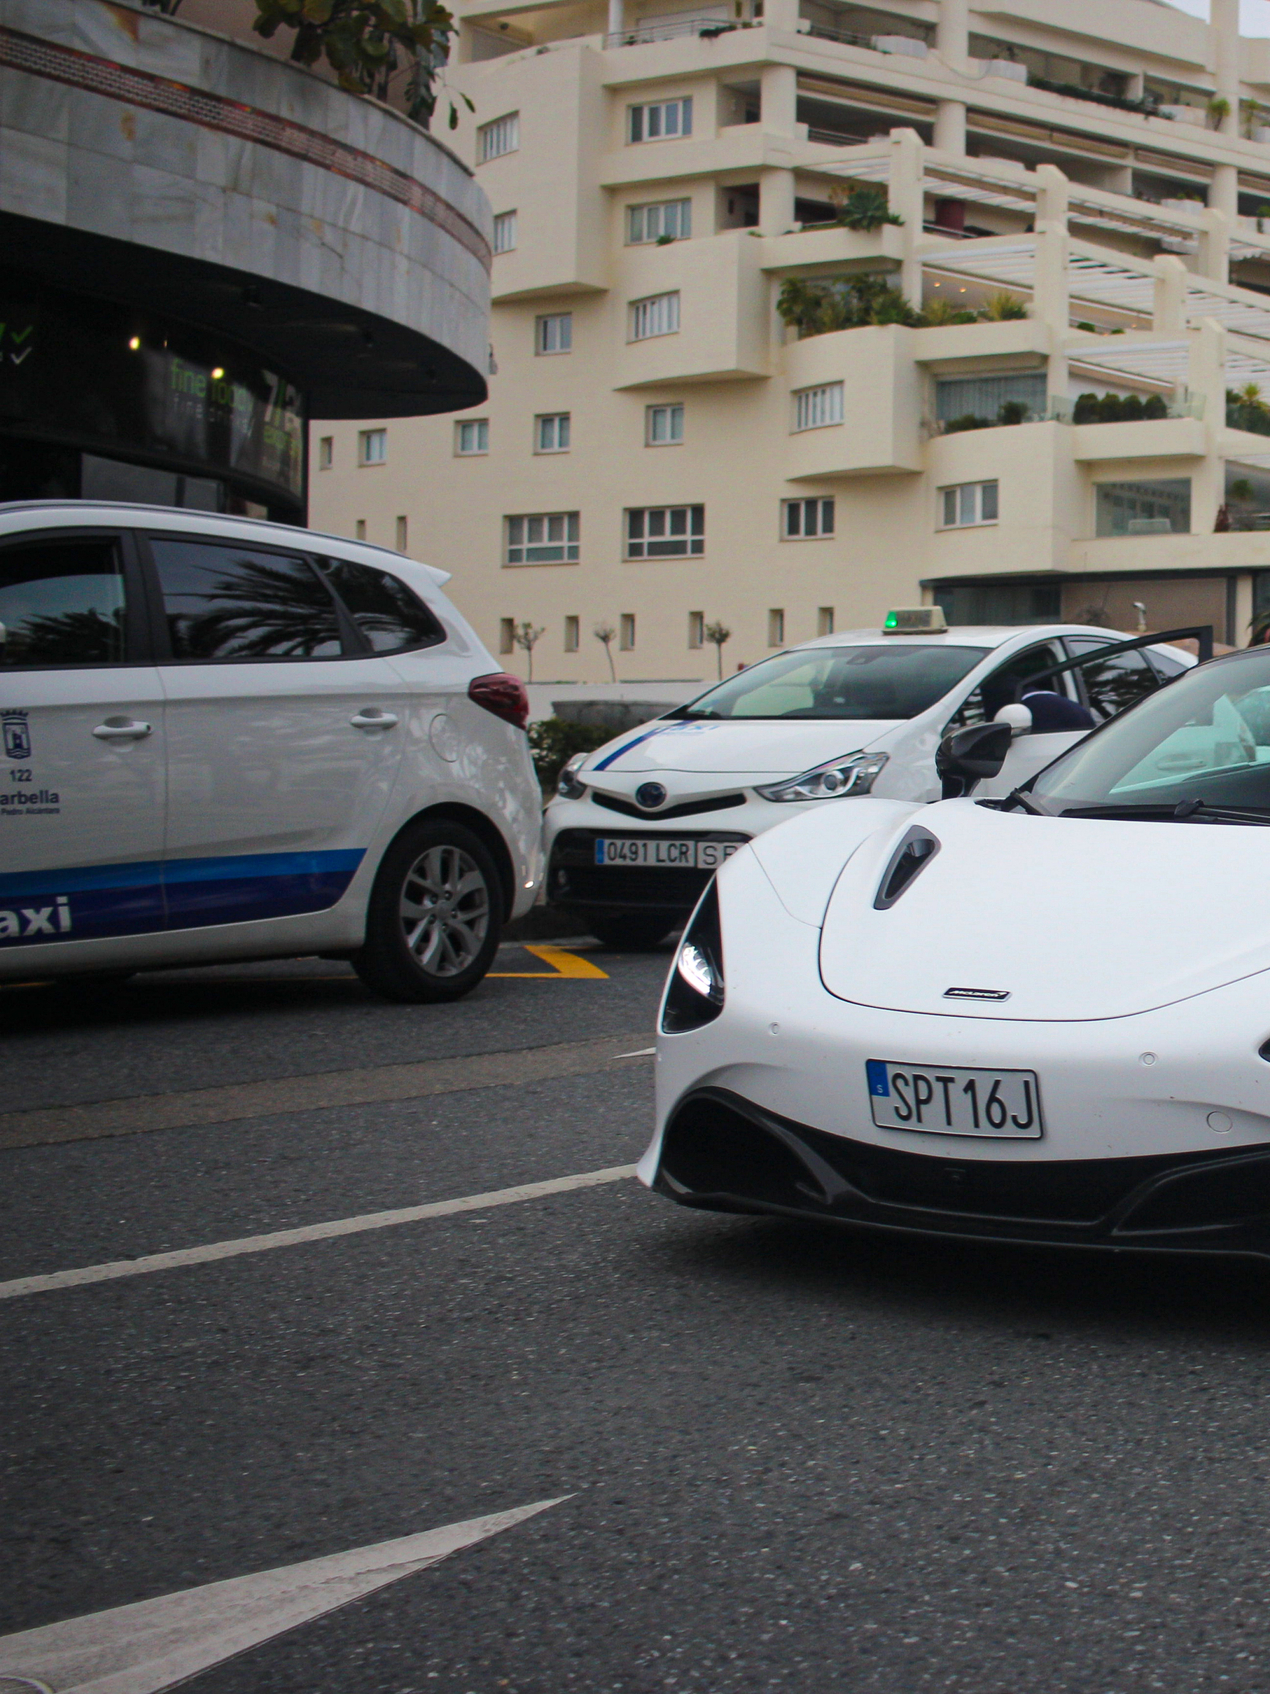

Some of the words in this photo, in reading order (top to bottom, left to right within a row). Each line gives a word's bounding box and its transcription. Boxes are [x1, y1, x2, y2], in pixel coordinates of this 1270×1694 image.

[9, 768, 33, 783] 122
[0, 789, 59, 806] arbella
[606, 841, 647, 863] 0491
[655, 843, 690, 864] LCR
[0, 896, 72, 938] axi
[877, 1084, 884, 1094] S
[891, 1072, 1034, 1130] SPT16J
